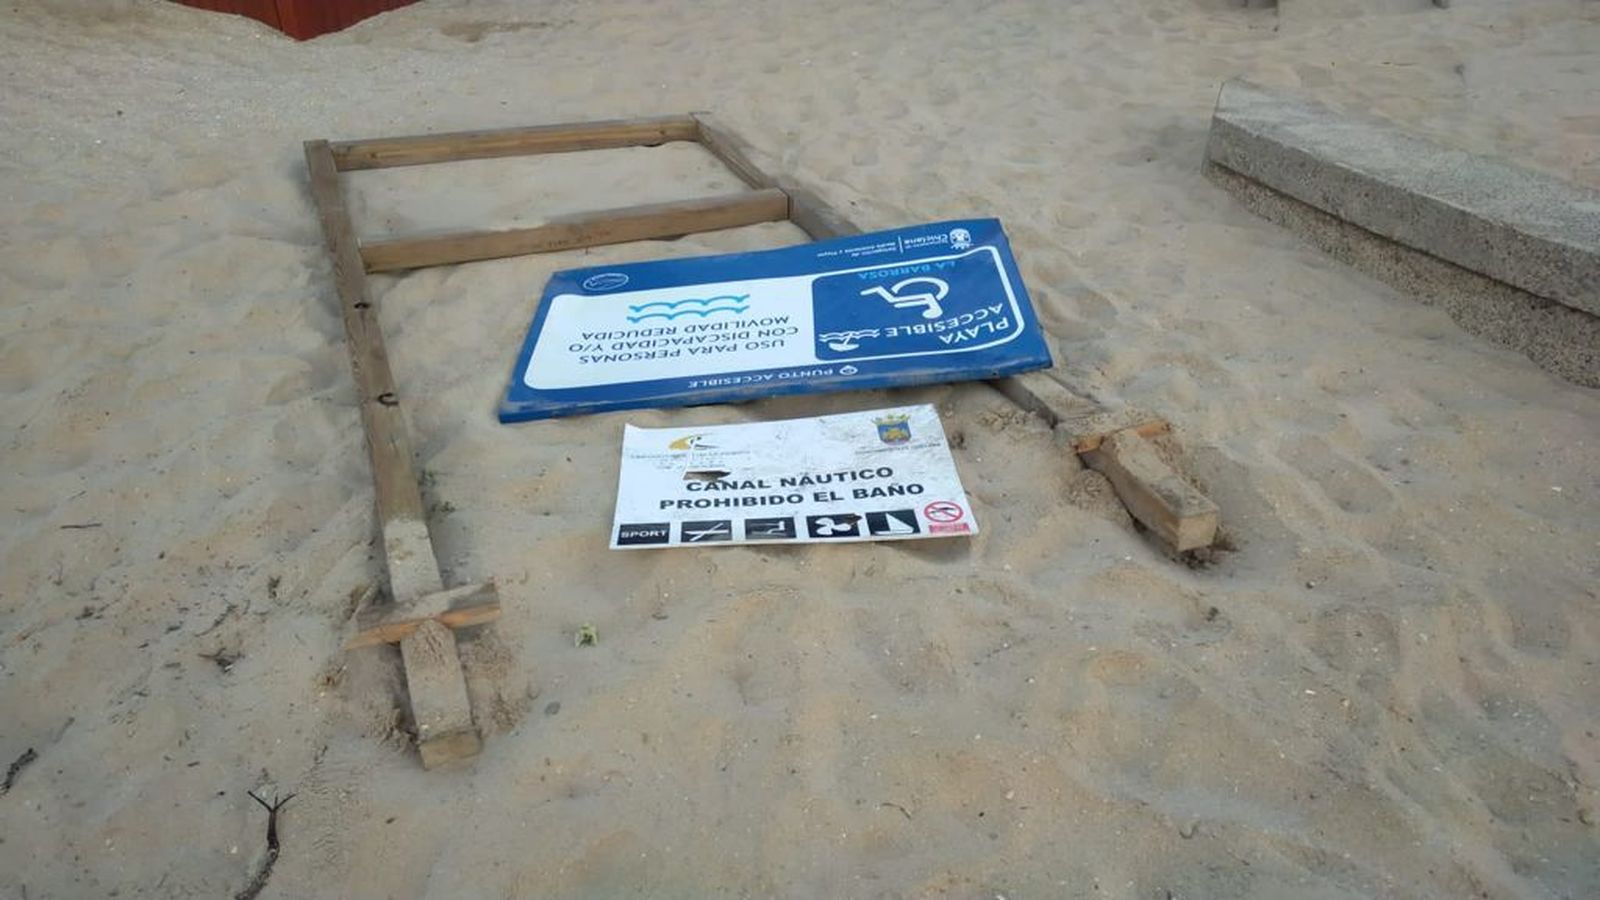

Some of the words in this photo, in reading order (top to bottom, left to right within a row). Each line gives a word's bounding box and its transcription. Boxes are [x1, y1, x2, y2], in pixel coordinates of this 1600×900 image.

[903, 233, 948, 244] Chiclana
[858, 264, 931, 279] BARROSA
[936, 261, 955, 270] LA
[684, 315, 790, 334] MOVILIDAD
[885, 303, 1004, 337] ACCESIBLE
[581, 326, 678, 340] REDUCIDA
[757, 327, 799, 338] CON
[939, 316, 1010, 344] PLAYA
[569, 342, 604, 352] Y/O
[611, 330, 750, 350] DISCAPACIDAD
[741, 338, 785, 351] USO
[578, 348, 682, 364] PERSONAS
[688, 343, 738, 355] PARA
[687, 373, 774, 389] ACCESIBLE
[778, 368, 833, 380] PUNTO
[685, 479, 771, 491] CANAL
[779, 467, 894, 487] NÁUTICO
[659, 493, 804, 510] PROHIBIDO
[813, 491, 845, 503] EL
[852, 482, 925, 500] BAÑO
[620, 529, 668, 538] SPORT
